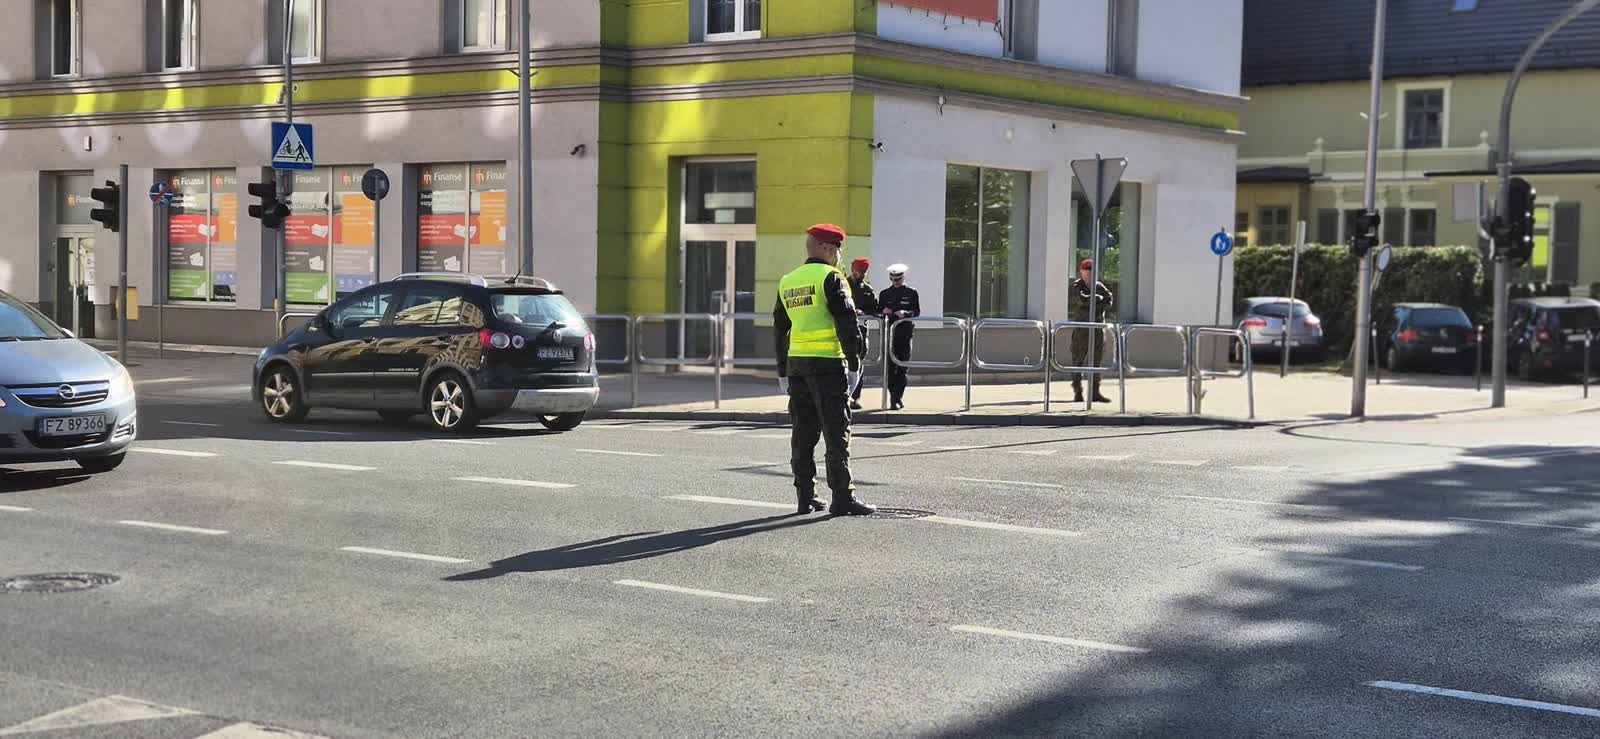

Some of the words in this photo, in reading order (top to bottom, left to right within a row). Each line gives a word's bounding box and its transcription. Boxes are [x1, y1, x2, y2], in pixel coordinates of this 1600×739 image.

[181, 177, 204, 185] Finanse
[295, 175, 321, 184] Finanse
[434, 172, 462, 181] Finanse
[46, 419, 64, 432] FZ
[68, 416, 103, 430] 89366
